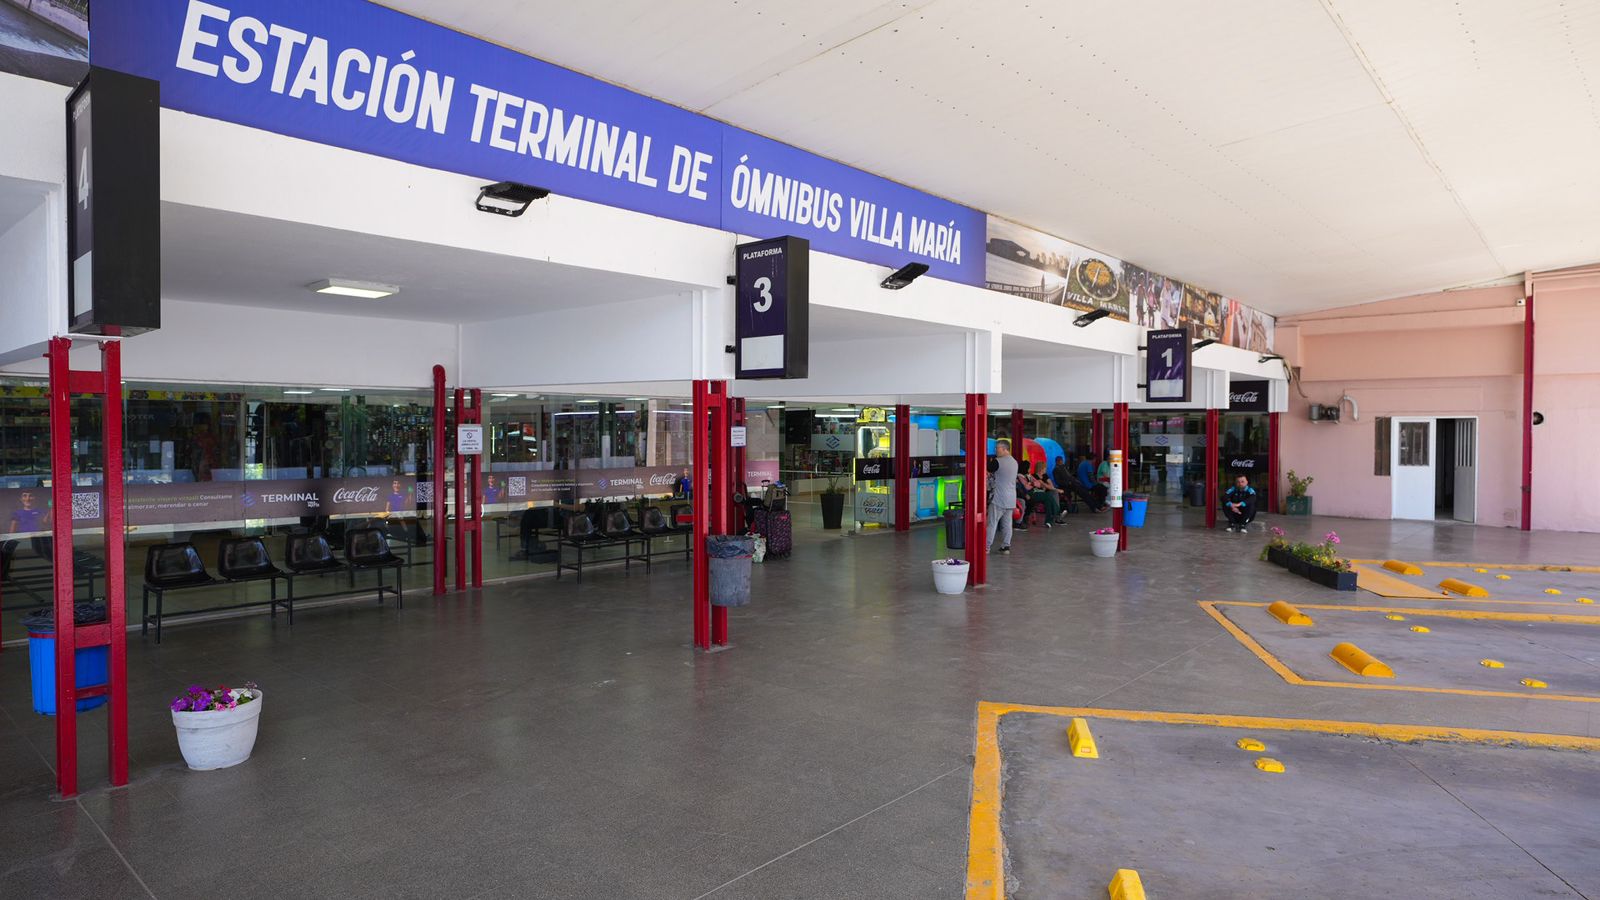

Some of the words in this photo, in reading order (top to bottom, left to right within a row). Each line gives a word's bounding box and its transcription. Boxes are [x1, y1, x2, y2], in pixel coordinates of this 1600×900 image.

[176, 0, 455, 135] ESTACIÓN
[470, 83, 658, 188] TERMINAL
[667, 144, 713, 200] DE
[730, 154, 843, 232] ÓMNIBUS
[850, 197, 903, 250] VILLA
[908, 221, 961, 265] MARÍA
[77, 146, 89, 210] 4
[743, 247, 783, 260] PLATAFORMA
[753, 276, 773, 313] 3
[1066, 292, 1094, 305] VILLA
[1161, 348, 1173, 368] 1
[610, 478, 643, 486] TERMINAL
[261, 492, 319, 503] TERMINAL
